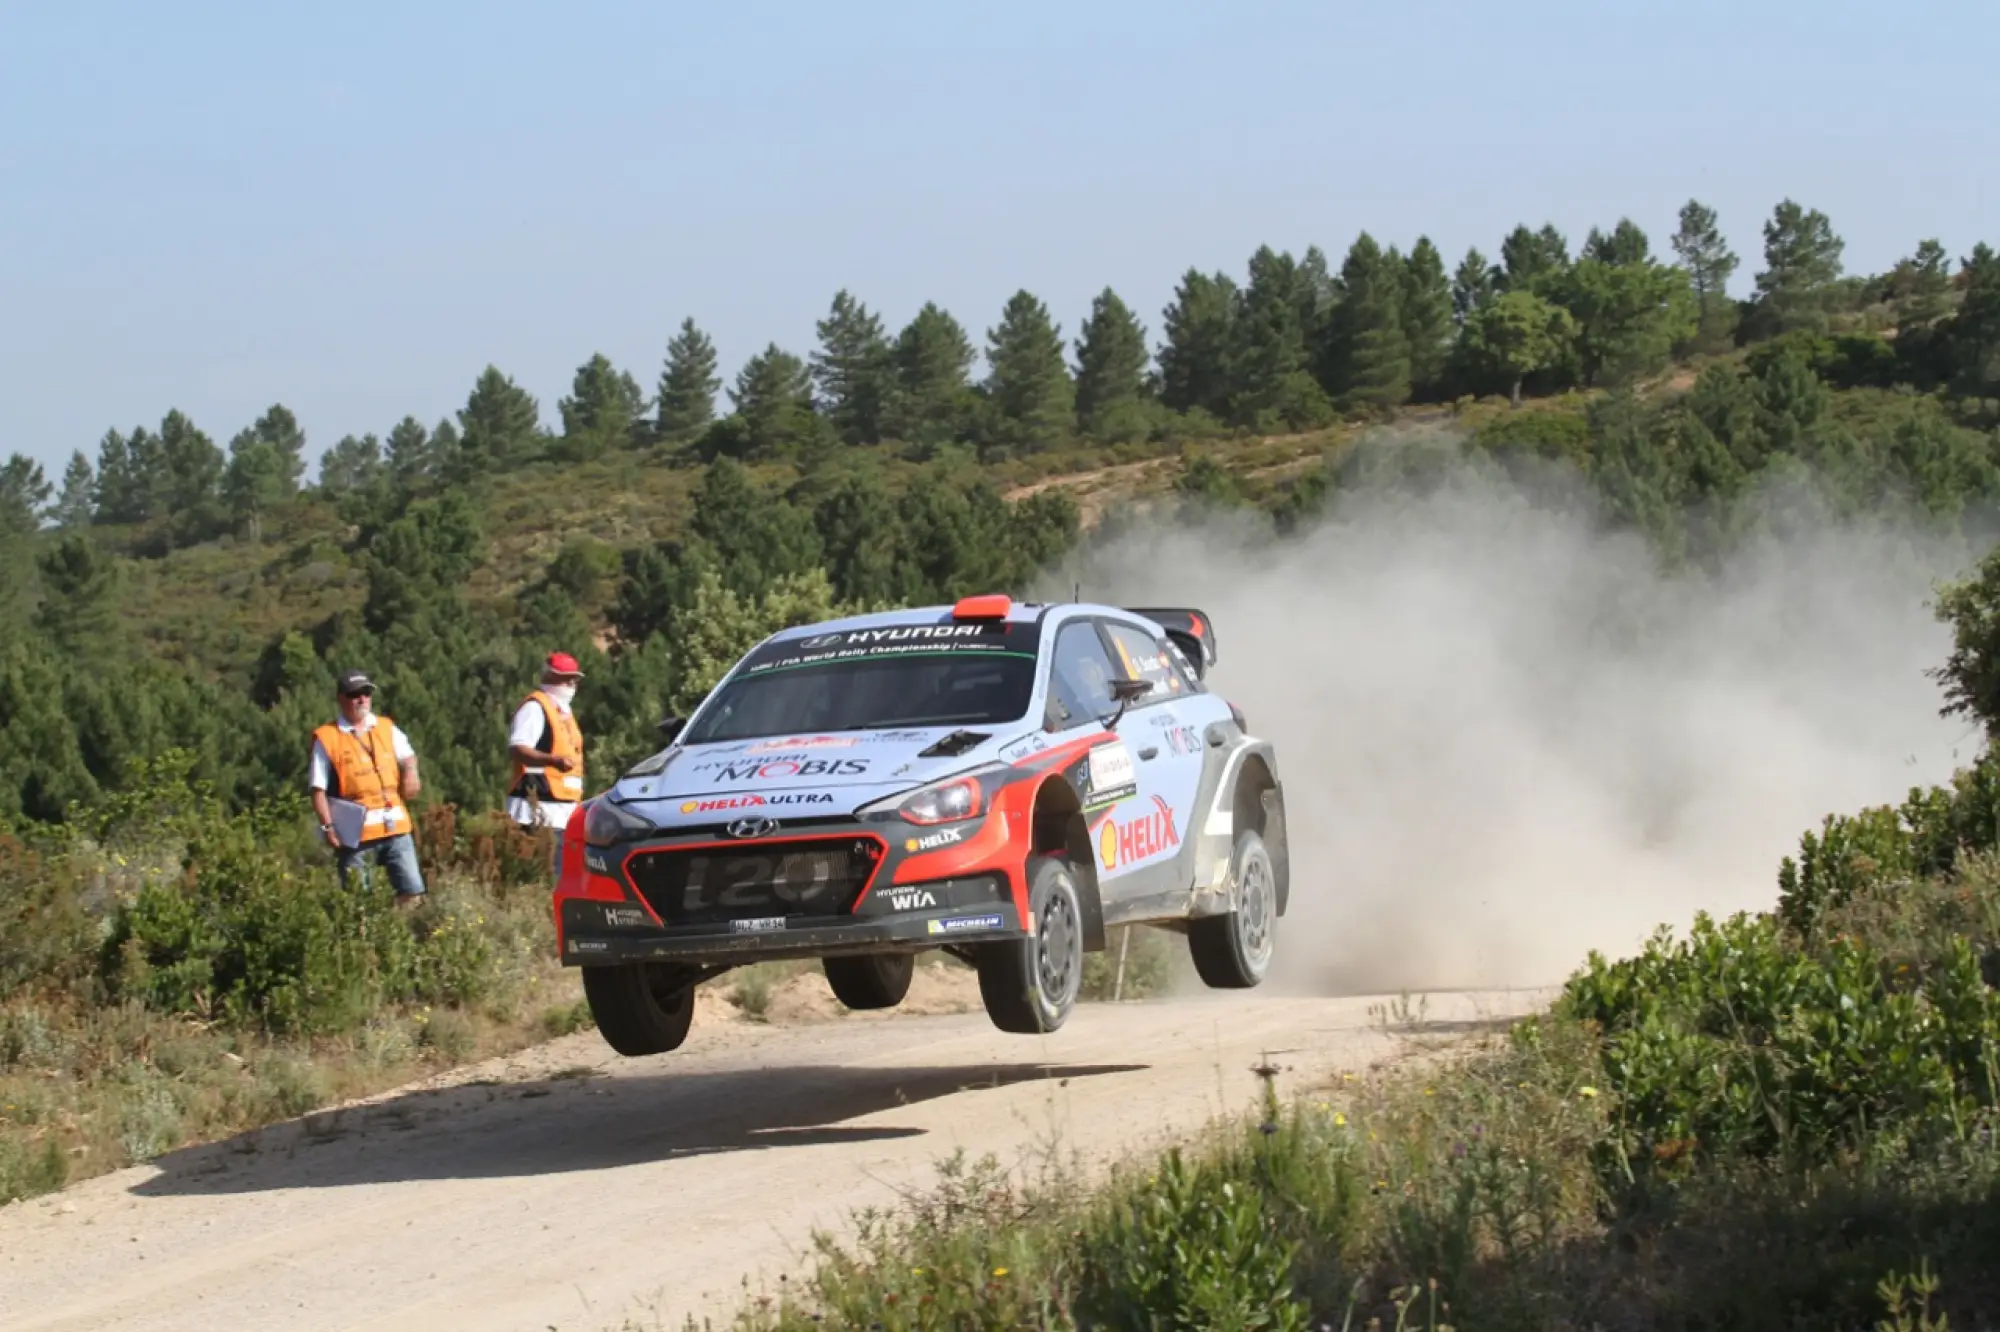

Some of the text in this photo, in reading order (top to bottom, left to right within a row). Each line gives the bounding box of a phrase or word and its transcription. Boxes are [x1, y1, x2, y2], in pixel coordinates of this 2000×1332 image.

[847, 625, 983, 643] HYUNDAI
[803, 652, 836, 662] World
[838, 648, 867, 659] Rally
[870, 642, 950, 655] Championship
[692, 753, 808, 772] HYUNDAI
[714, 758, 871, 783] MOBIS
[700, 793, 834, 812] HELIX ULTRA
[919, 828, 963, 849] HELIX
[1118, 795, 1180, 865] HELIX
[945, 916, 999, 928] MICHELIN
